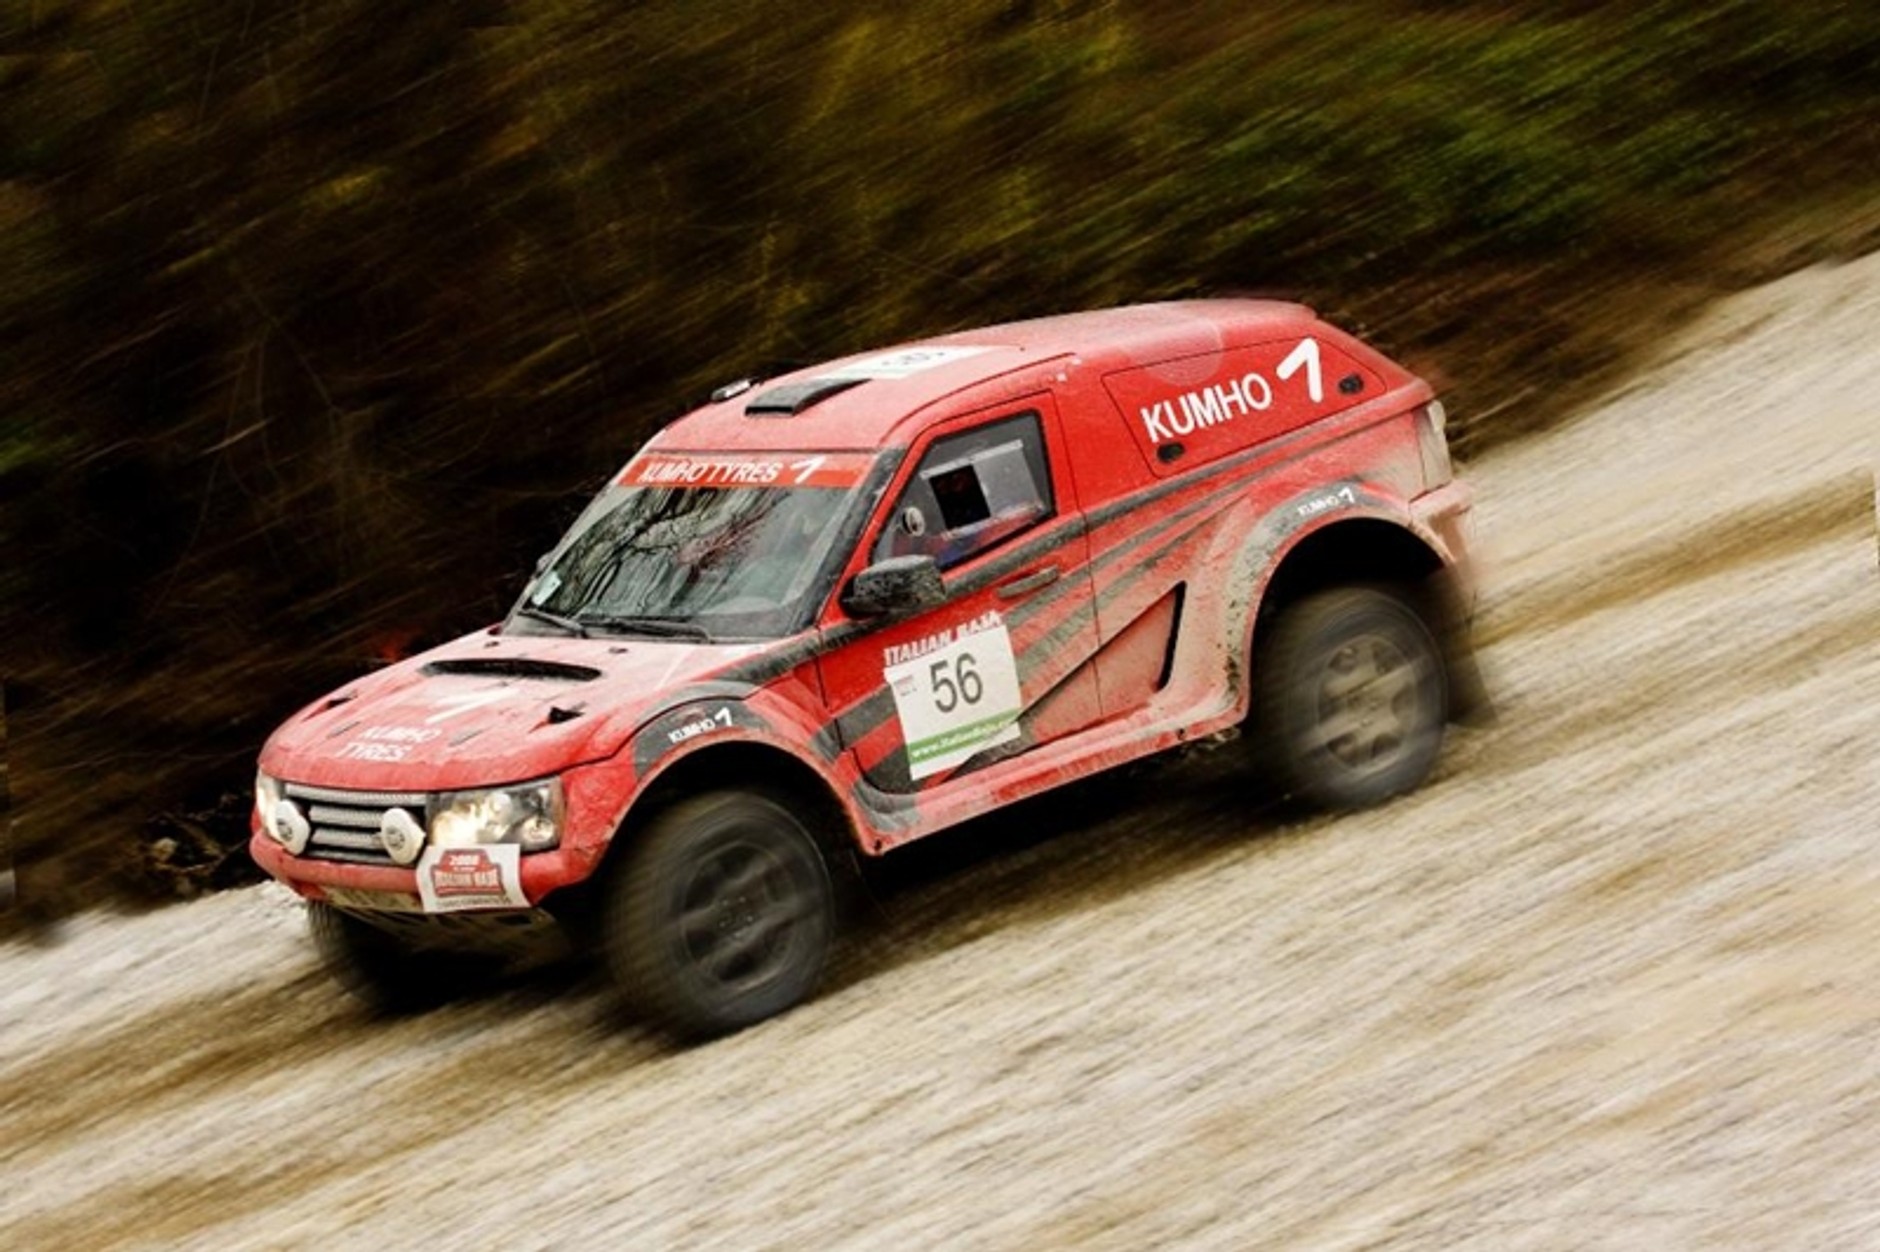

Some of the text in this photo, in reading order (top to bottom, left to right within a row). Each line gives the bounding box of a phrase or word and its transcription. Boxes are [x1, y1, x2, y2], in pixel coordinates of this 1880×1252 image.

[1140, 372, 1273, 443] KUMHO
[704, 461, 783, 483] TYRES
[883, 629, 950, 667] ITALIAN
[930, 652, 983, 713] 56
